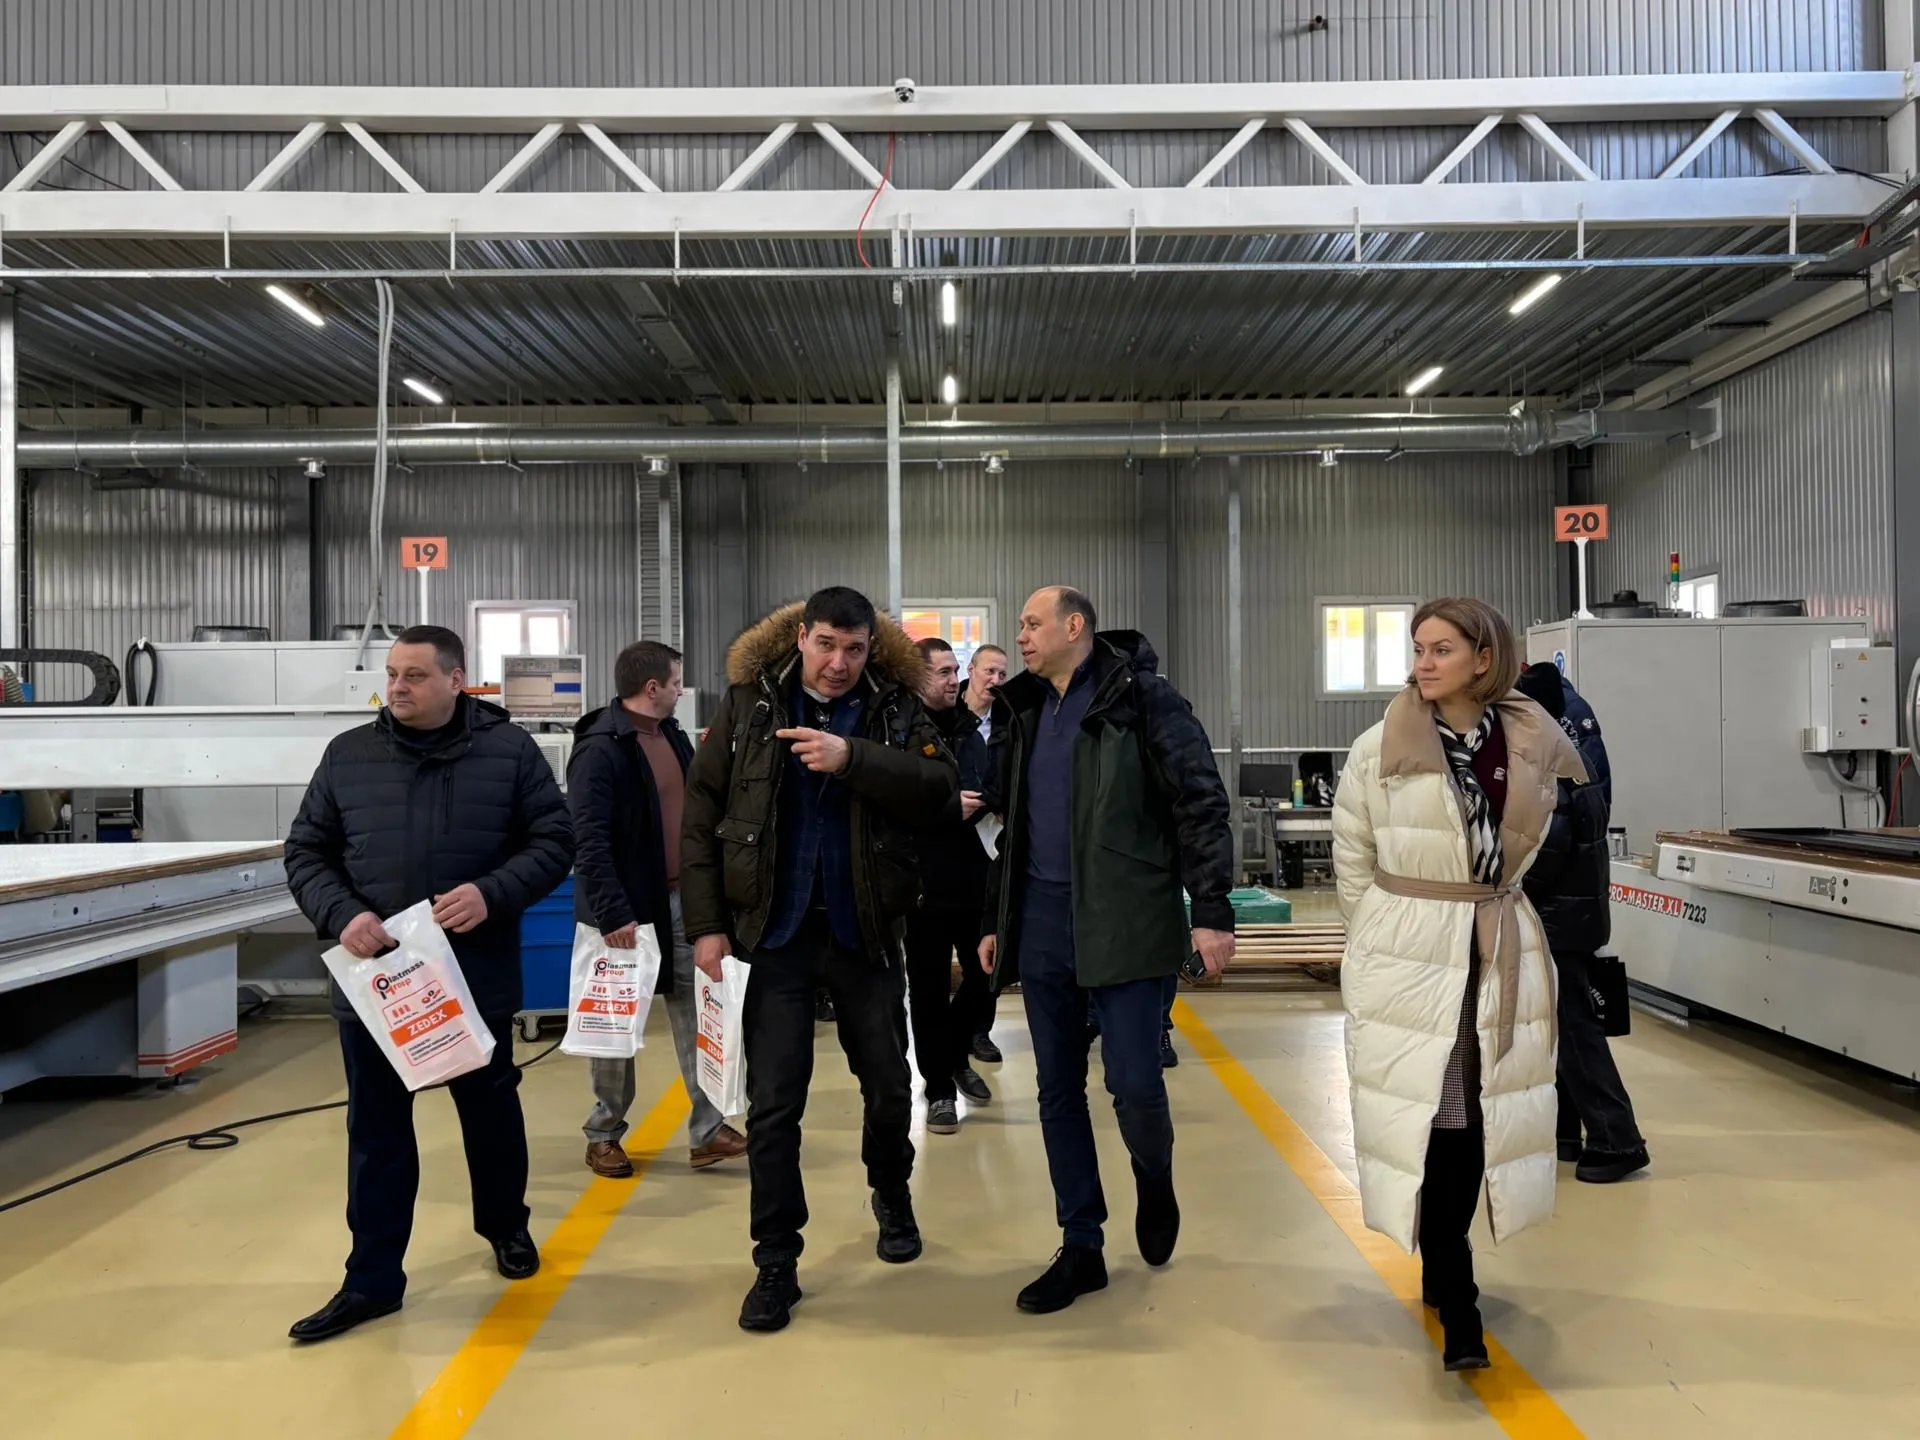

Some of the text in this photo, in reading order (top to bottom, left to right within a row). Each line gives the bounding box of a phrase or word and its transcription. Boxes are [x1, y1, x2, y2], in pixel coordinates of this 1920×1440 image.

[1564, 512, 1600, 533] 20
[412, 543, 439, 562] 19
[1608, 885, 1707, 924] RO-MASTER XL 7223
[407, 1008, 448, 1036] ZEDEX
